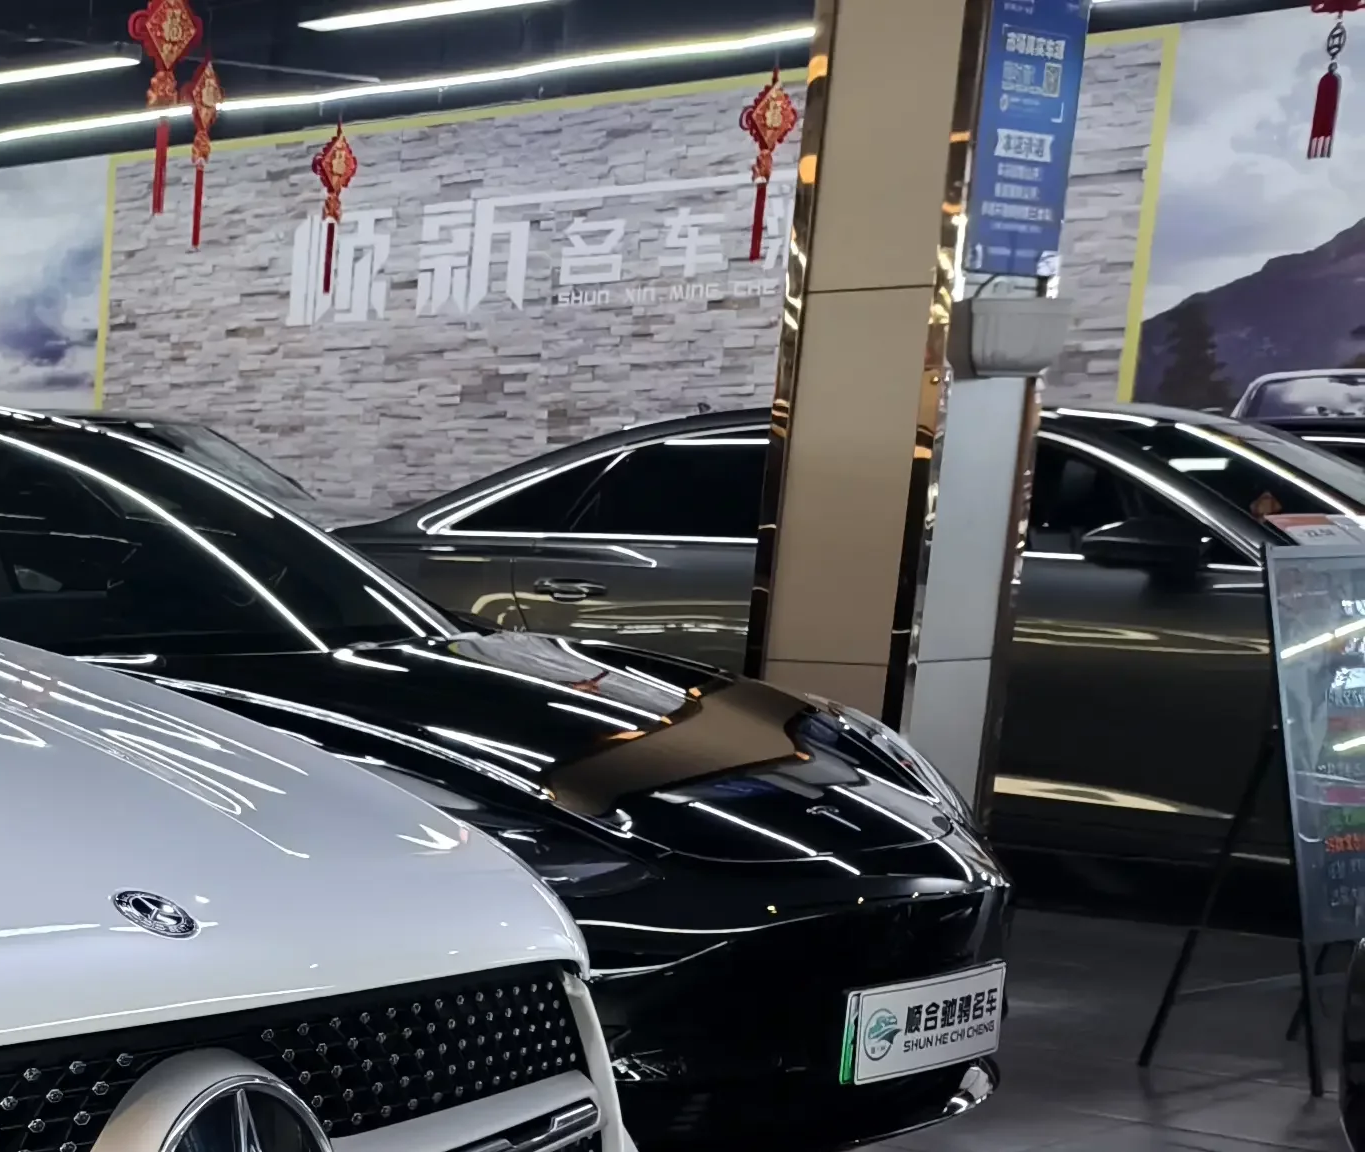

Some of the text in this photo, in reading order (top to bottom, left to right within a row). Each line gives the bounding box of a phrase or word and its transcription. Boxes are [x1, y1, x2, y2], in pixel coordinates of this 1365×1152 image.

[558, 290, 610, 308] SHUN
[904, 988, 998, 1035] 顺合驰骋名车
[903, 1036, 934, 1053] SHUN
[935, 1033, 949, 1046] HE
[950, 1028, 965, 1042] CHI
[967, 1020, 995, 1038] CHENG
